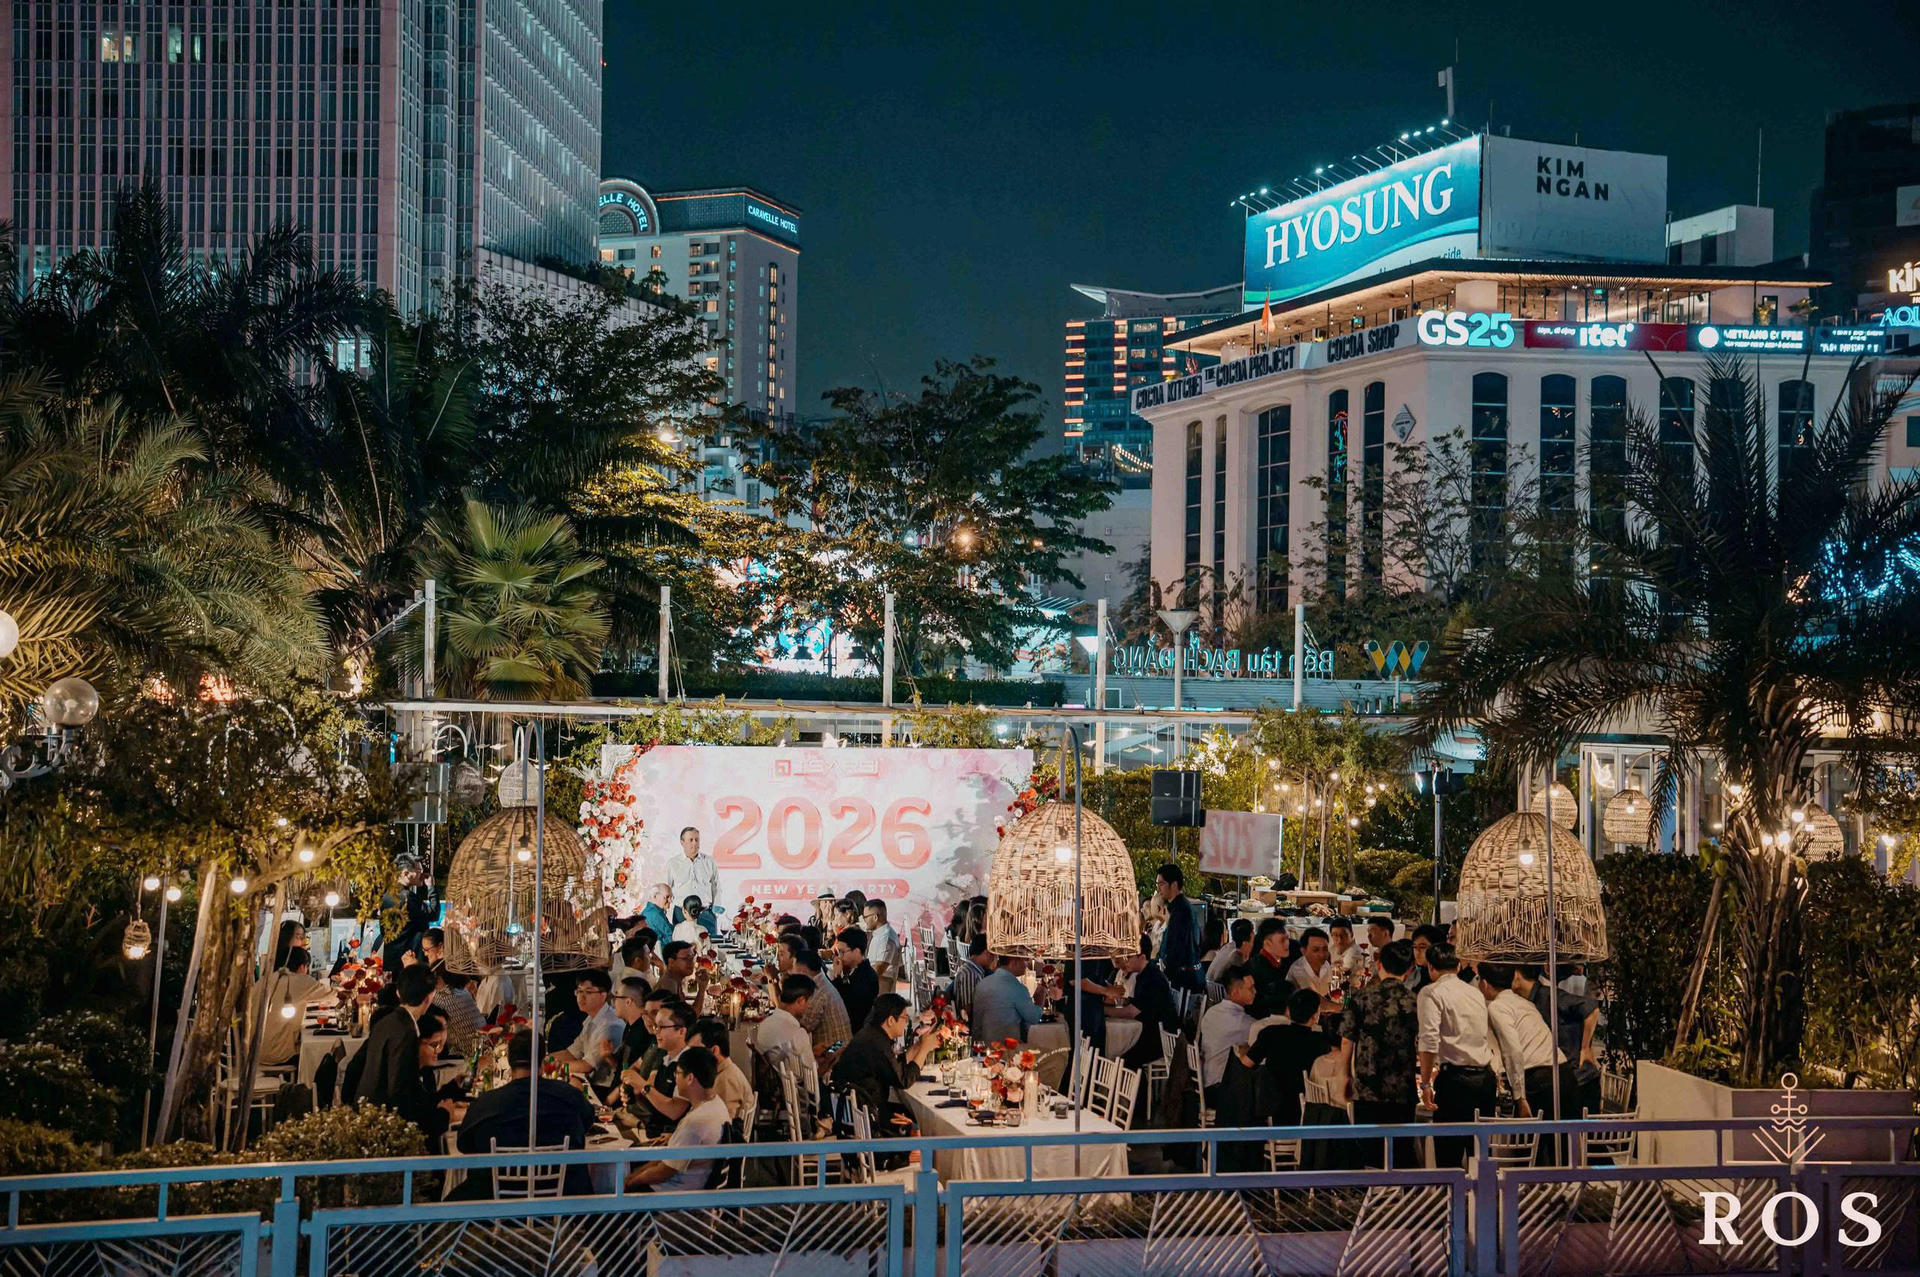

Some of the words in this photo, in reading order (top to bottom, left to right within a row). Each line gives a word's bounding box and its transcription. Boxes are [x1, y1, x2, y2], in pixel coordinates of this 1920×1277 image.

[1537, 156, 1584, 179] KIM
[1536, 175, 1609, 201] NGAN
[626, 197, 650, 232] HOTEL
[748, 204, 779, 227] CARAVELLE
[780, 216, 798, 235] HOTEL
[1263, 163, 1453, 269] HYOSUNG
[1327, 336, 1365, 363] COCOA
[1367, 324, 1400, 353] SHOP
[1417, 309, 1515, 348] GS25
[1215, 361, 1248, 387] COCOA
[1248, 345, 1297, 379] PROJECT
[1135, 383, 1165, 410] COCOA
[712, 795, 933, 871] 2026
[751, 884, 788, 895] NEW
